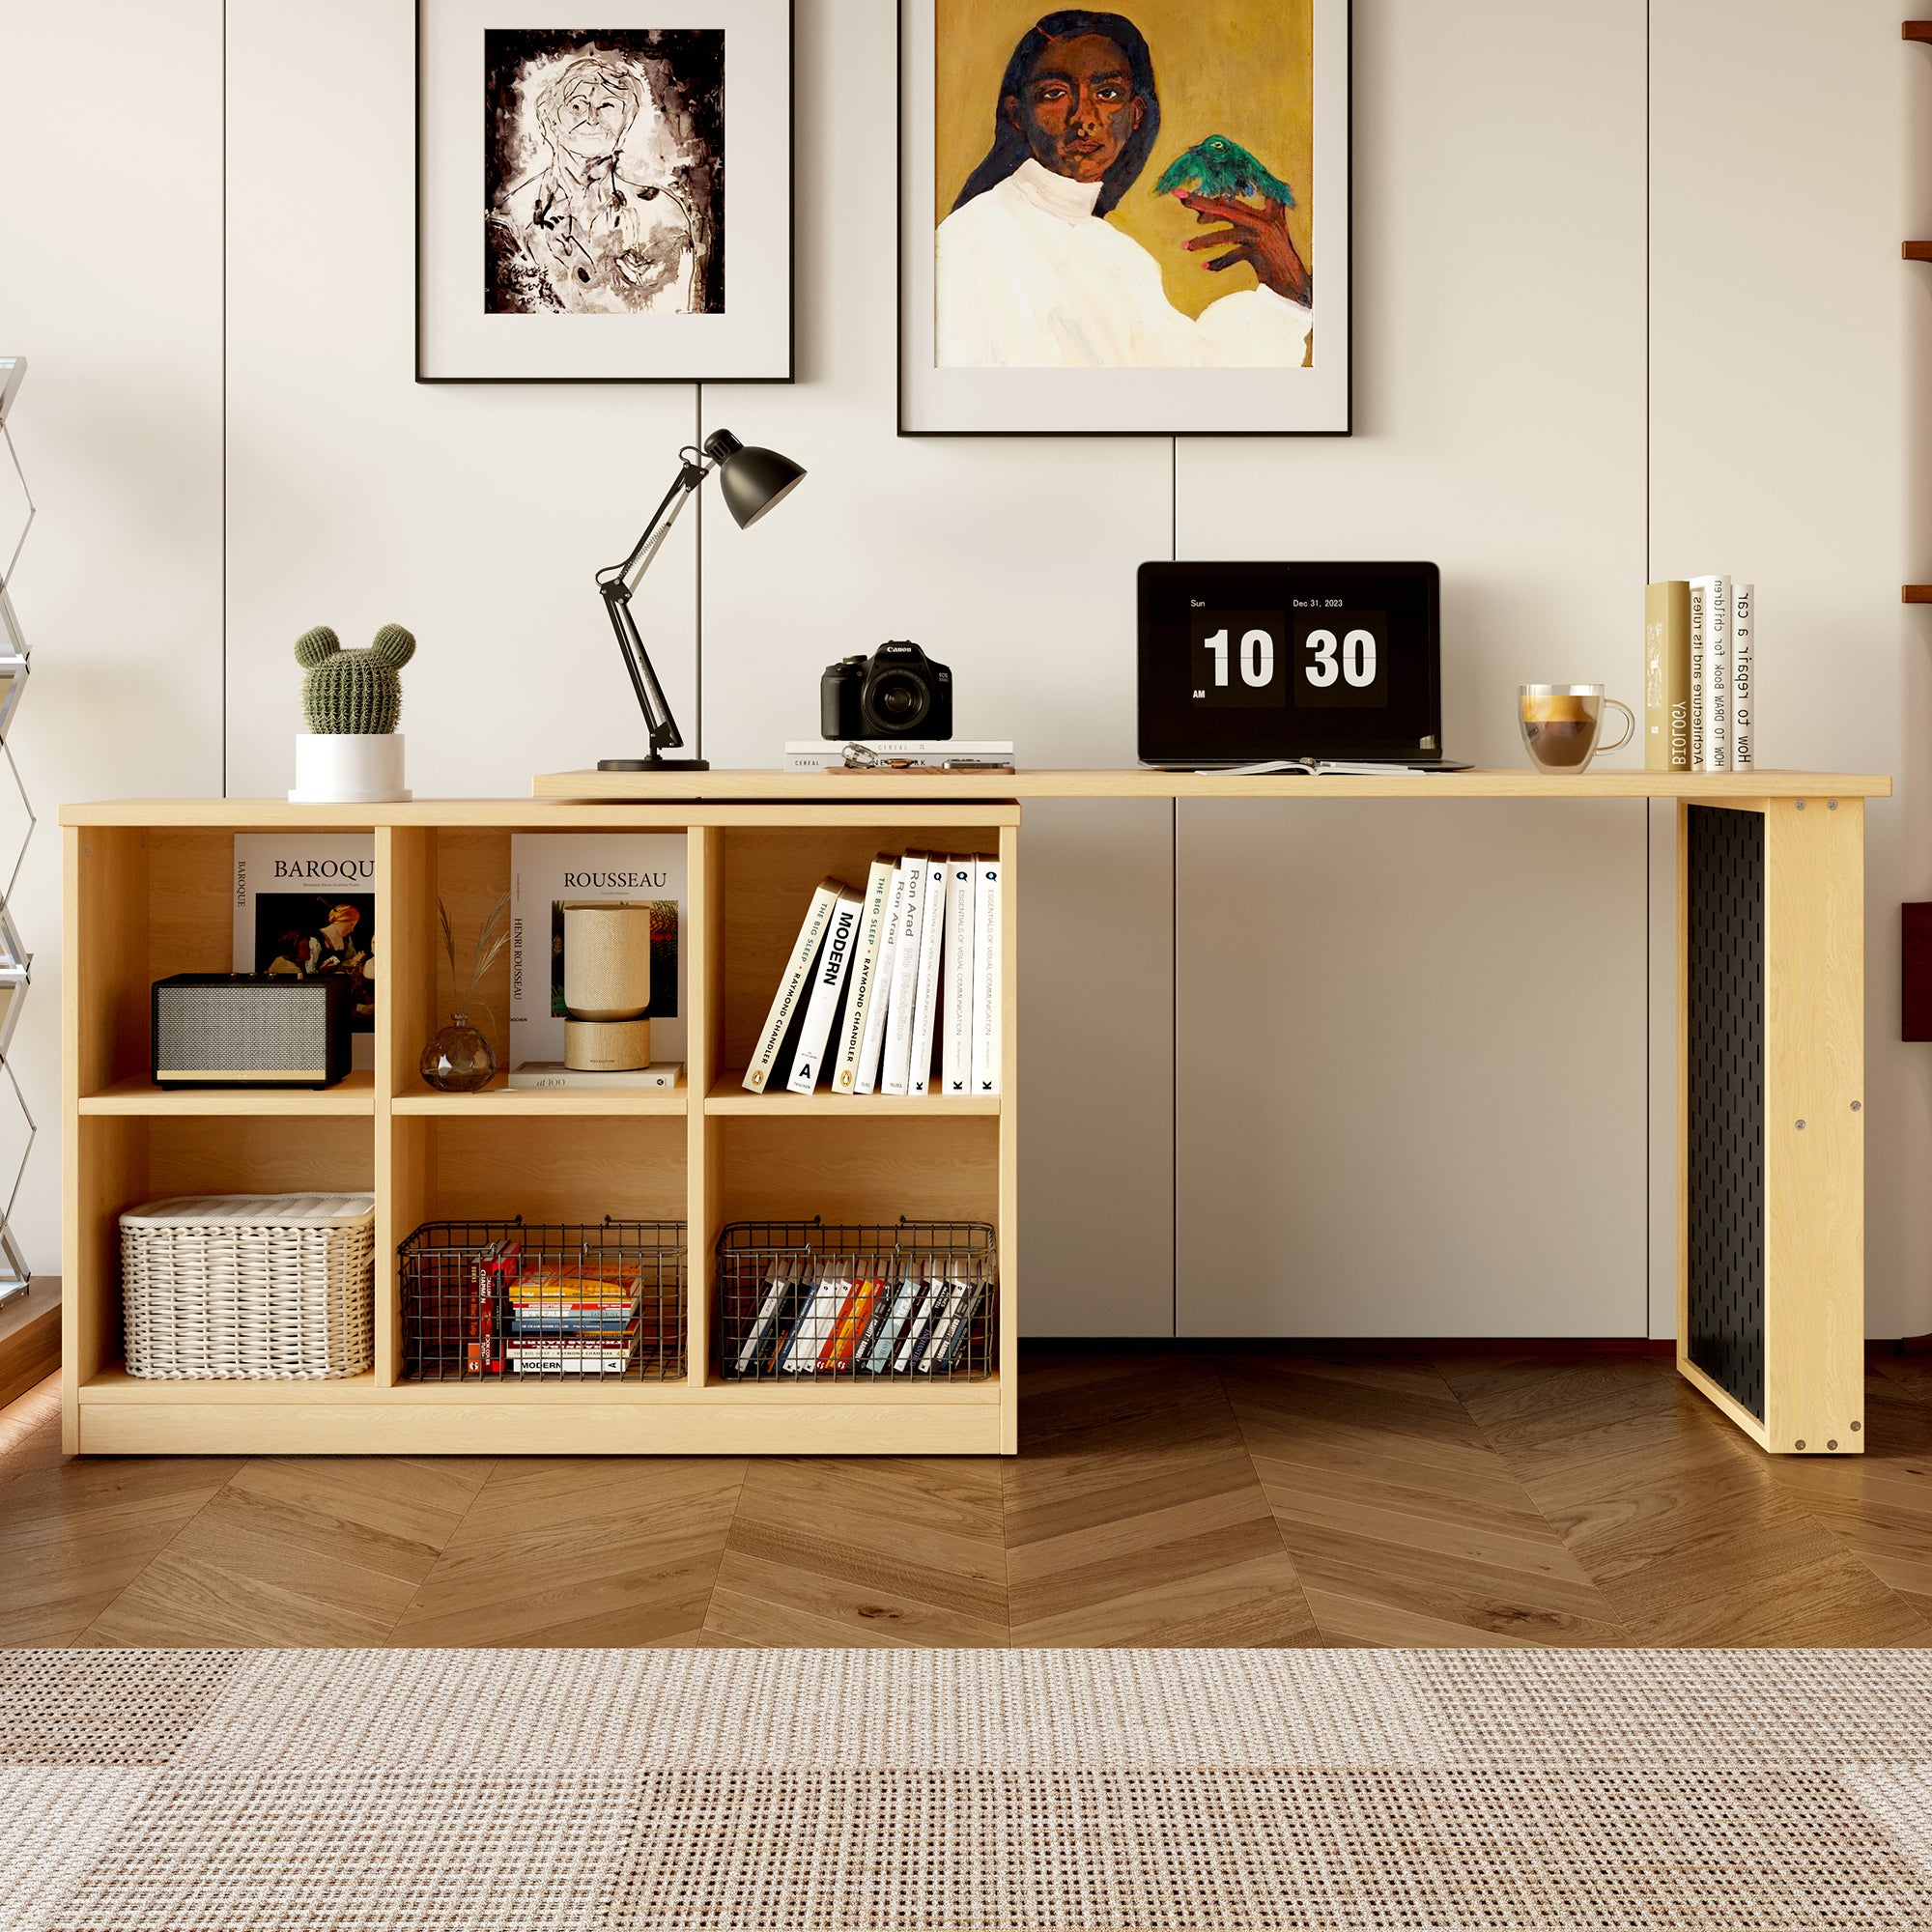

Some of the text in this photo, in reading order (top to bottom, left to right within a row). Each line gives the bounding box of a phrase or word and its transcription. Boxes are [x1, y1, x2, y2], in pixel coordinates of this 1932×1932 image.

[1190, 599, 1206, 608] Sun
[1293, 599, 1344, 609] Dec 31, 2023
[1204, 629, 1274, 687] 10
[1305, 629, 1377, 687] 30
[1192, 690, 1206, 698] AM
[237, 861, 247, 908] BAROQUE
[274, 860, 375, 881] BAROQU
[563, 872, 668, 888] ROUSSEAU
[909, 869, 920, 898] Ron
[894, 881, 905, 908] Ron
[888, 913, 899, 945] Arad
[905, 903, 917, 937] Arad
[513, 918, 523, 1001] HENRI ROUSSEAU
[823, 912, 854, 986] MODERN
[760, 902, 828, 1065] THE BIG SLEEP RAYMOND CHANDLER
[846, 877, 886, 1063] THE BIG SLEEP RAYMOND CHANDLER
[799, 1064, 811, 1079] A
